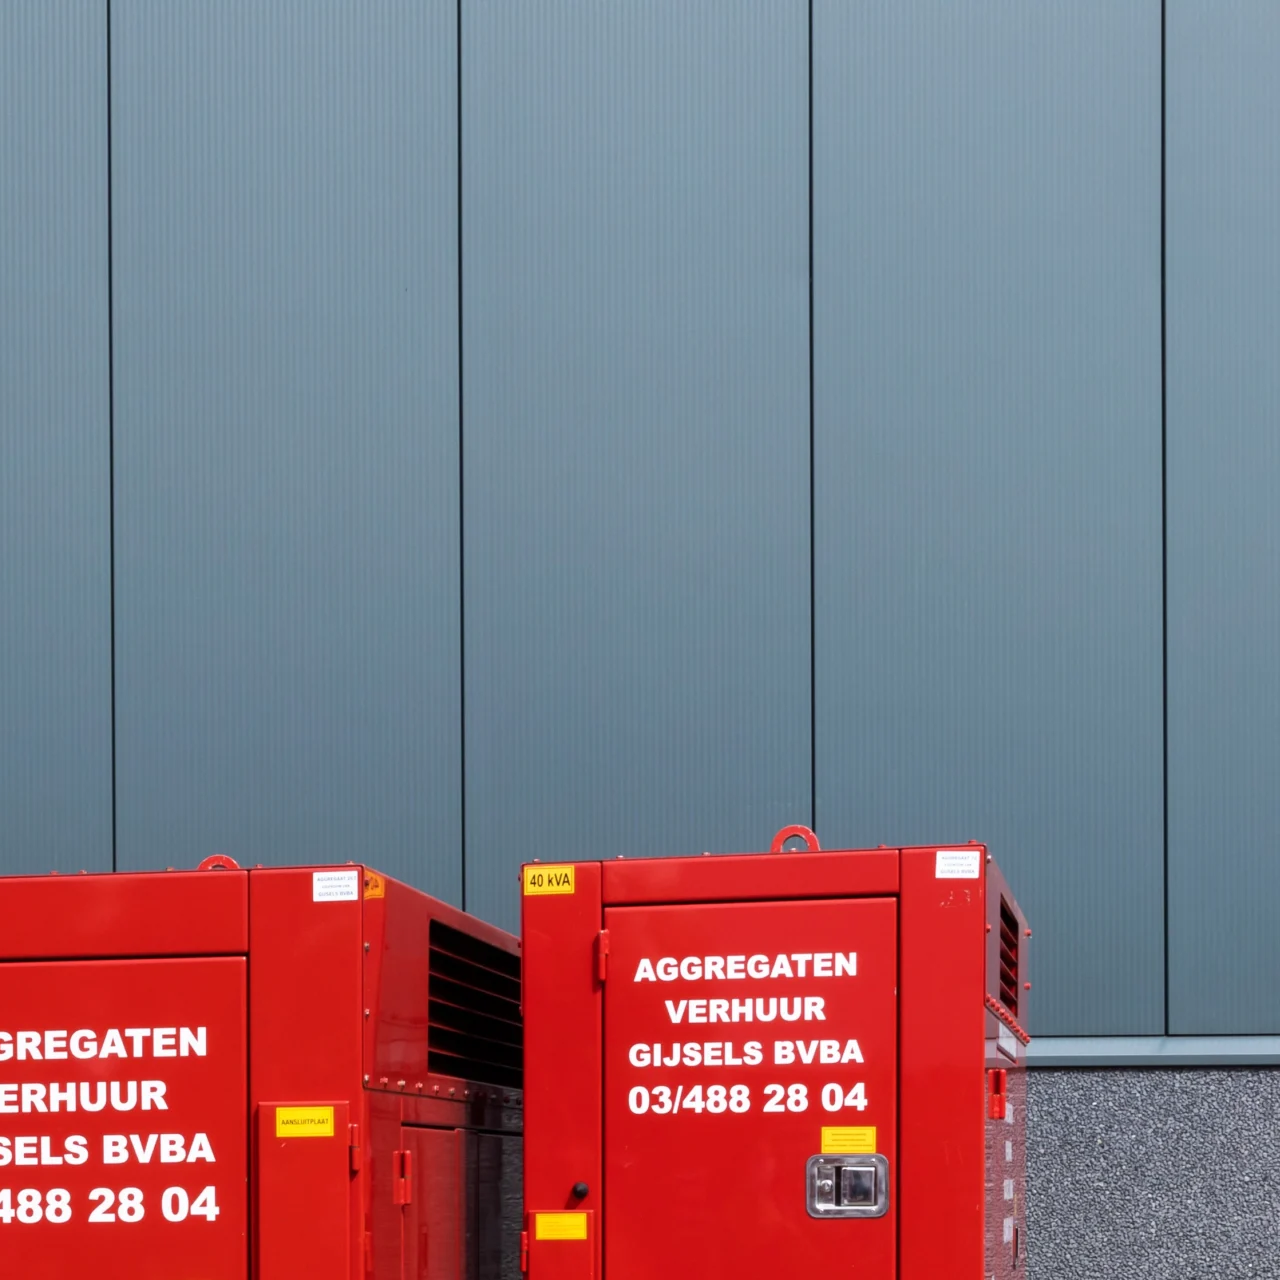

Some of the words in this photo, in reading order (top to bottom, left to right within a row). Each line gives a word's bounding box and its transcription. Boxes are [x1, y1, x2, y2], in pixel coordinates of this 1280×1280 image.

[530, 873, 544, 888] 40
[547, 872, 571, 887] kVA
[633, 951, 858, 983] AGGREGATEN
[664, 996, 826, 1024] VERHUUR
[628, 1040, 764, 1068] GIJSELS
[773, 1038, 864, 1065] BVBA
[628, 1084, 751, 1115] 03/488
[762, 1083, 809, 1113] 28
[821, 1082, 868, 1113] 04
[102, 1132, 217, 1165] BVBA
[87, 1186, 145, 1223] 28
[161, 1185, 220, 1223] 04
